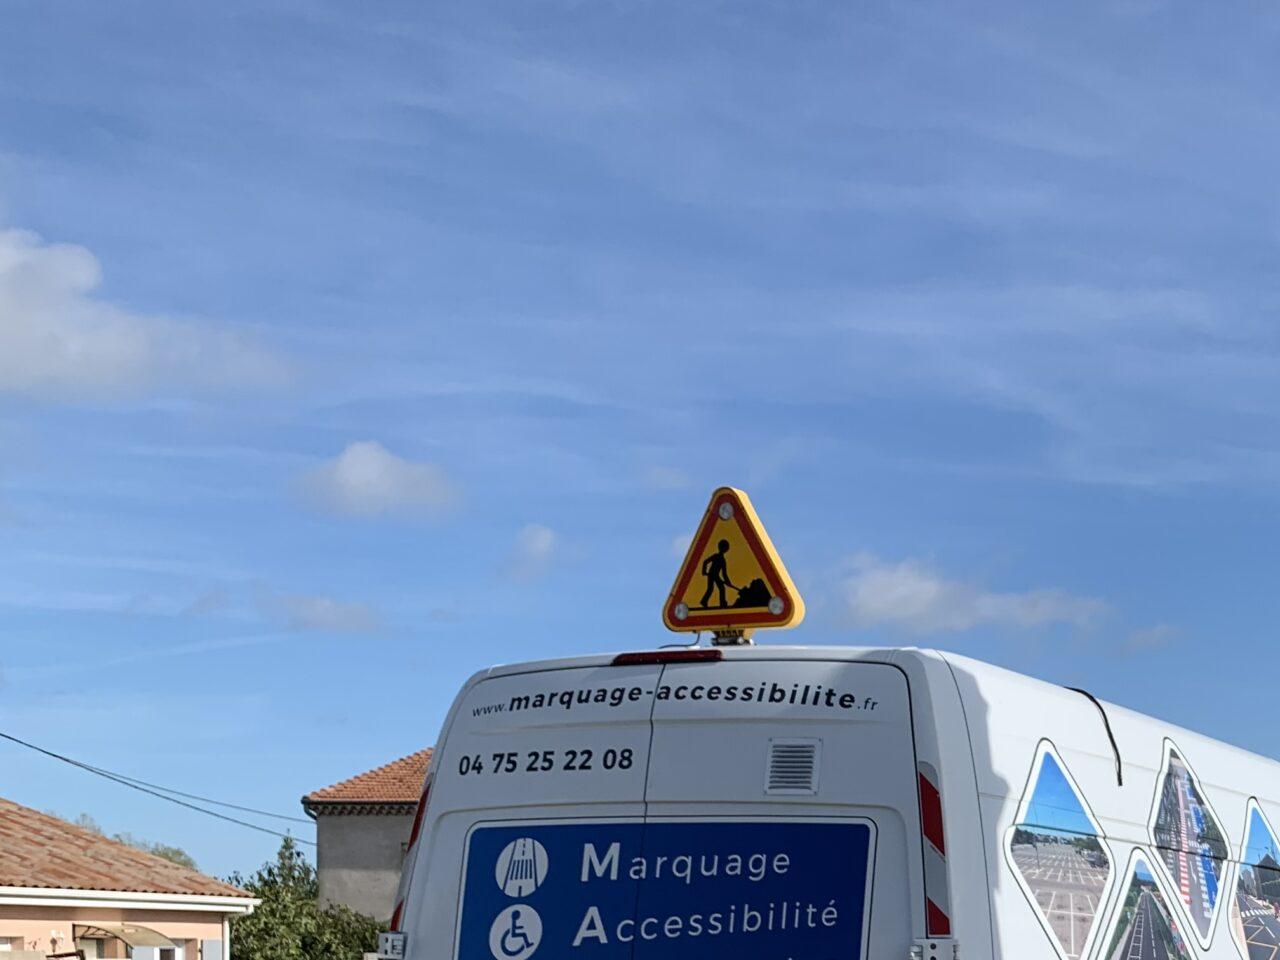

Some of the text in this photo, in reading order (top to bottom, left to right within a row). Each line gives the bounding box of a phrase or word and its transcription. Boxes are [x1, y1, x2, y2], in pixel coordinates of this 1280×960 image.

[458, 748, 634, 776] 04 75 25 22 08
[580, 842, 792, 886] Marquage
[571, 899, 839, 948] Accessibilité
